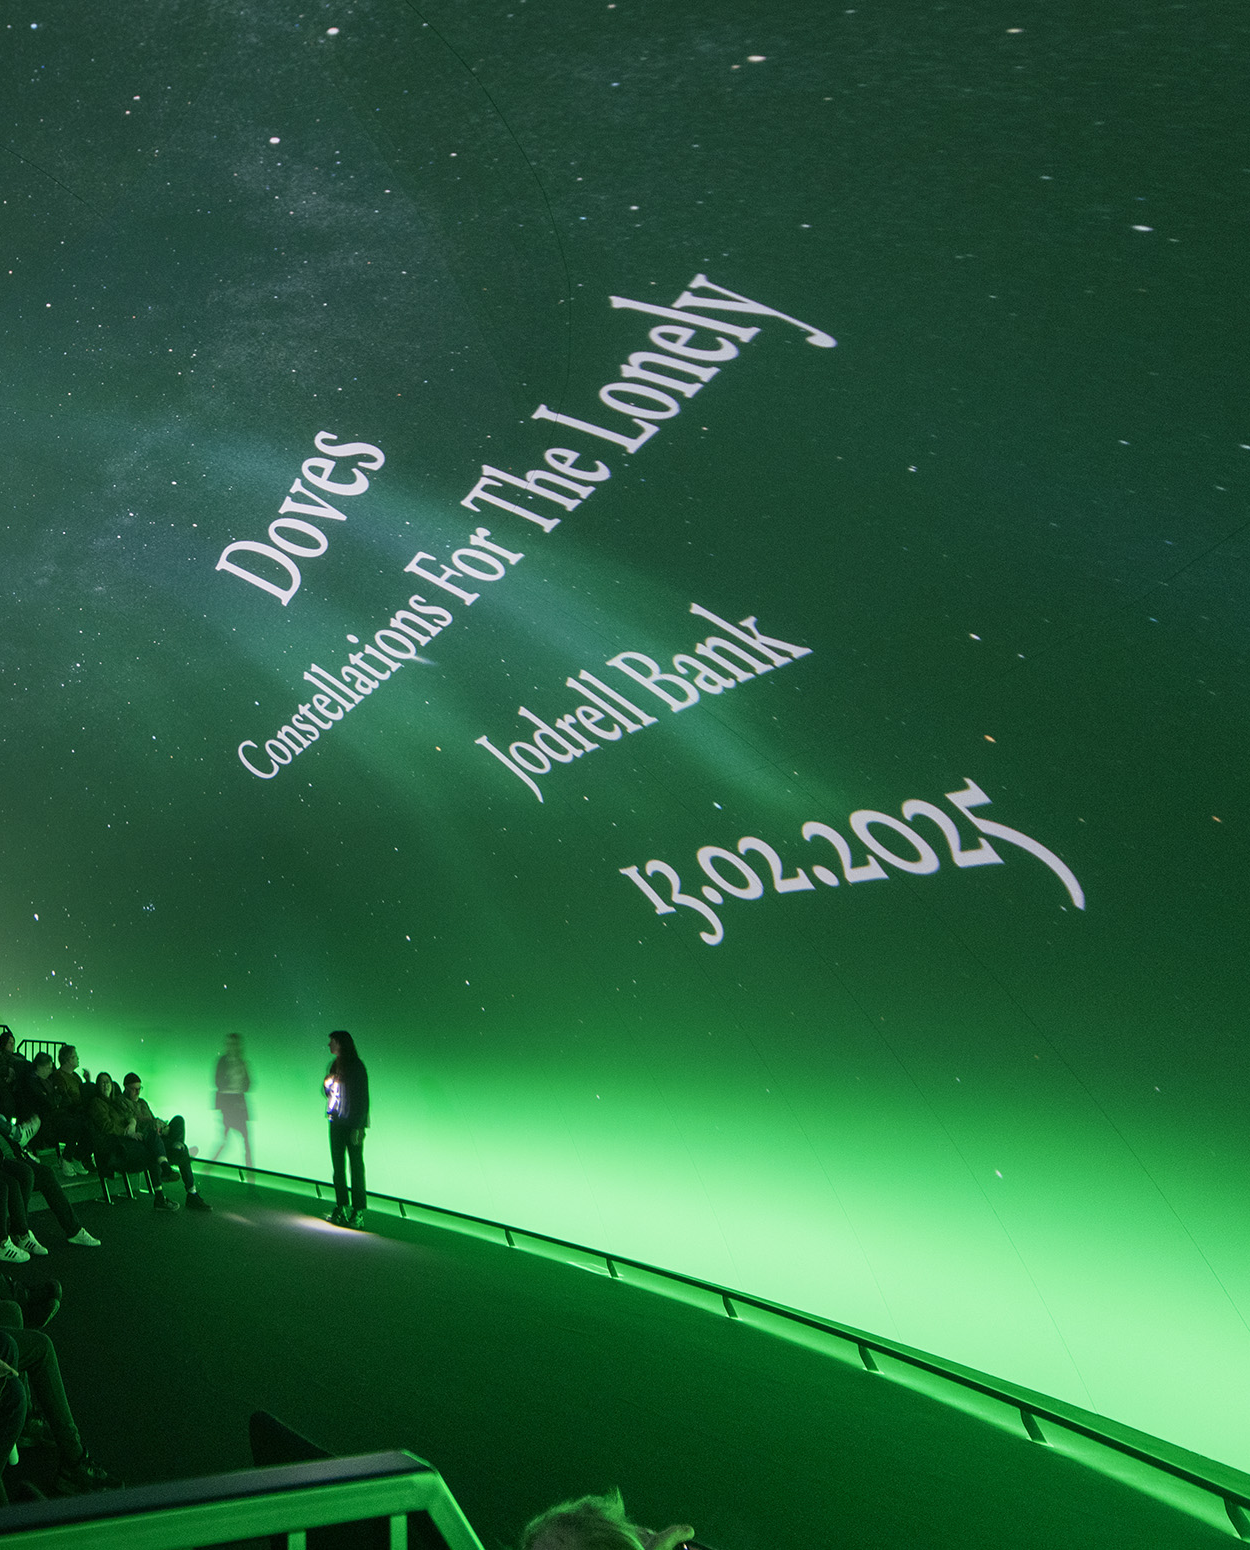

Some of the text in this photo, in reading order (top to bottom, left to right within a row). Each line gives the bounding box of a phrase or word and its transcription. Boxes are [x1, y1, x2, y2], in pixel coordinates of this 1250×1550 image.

[215, 430, 386, 607] Doves
[237, 273, 837, 780] Constellations For The Lonely
[475, 602, 813, 803] Jodrell Bank
[618, 777, 1085, 945] 13.02.2025
